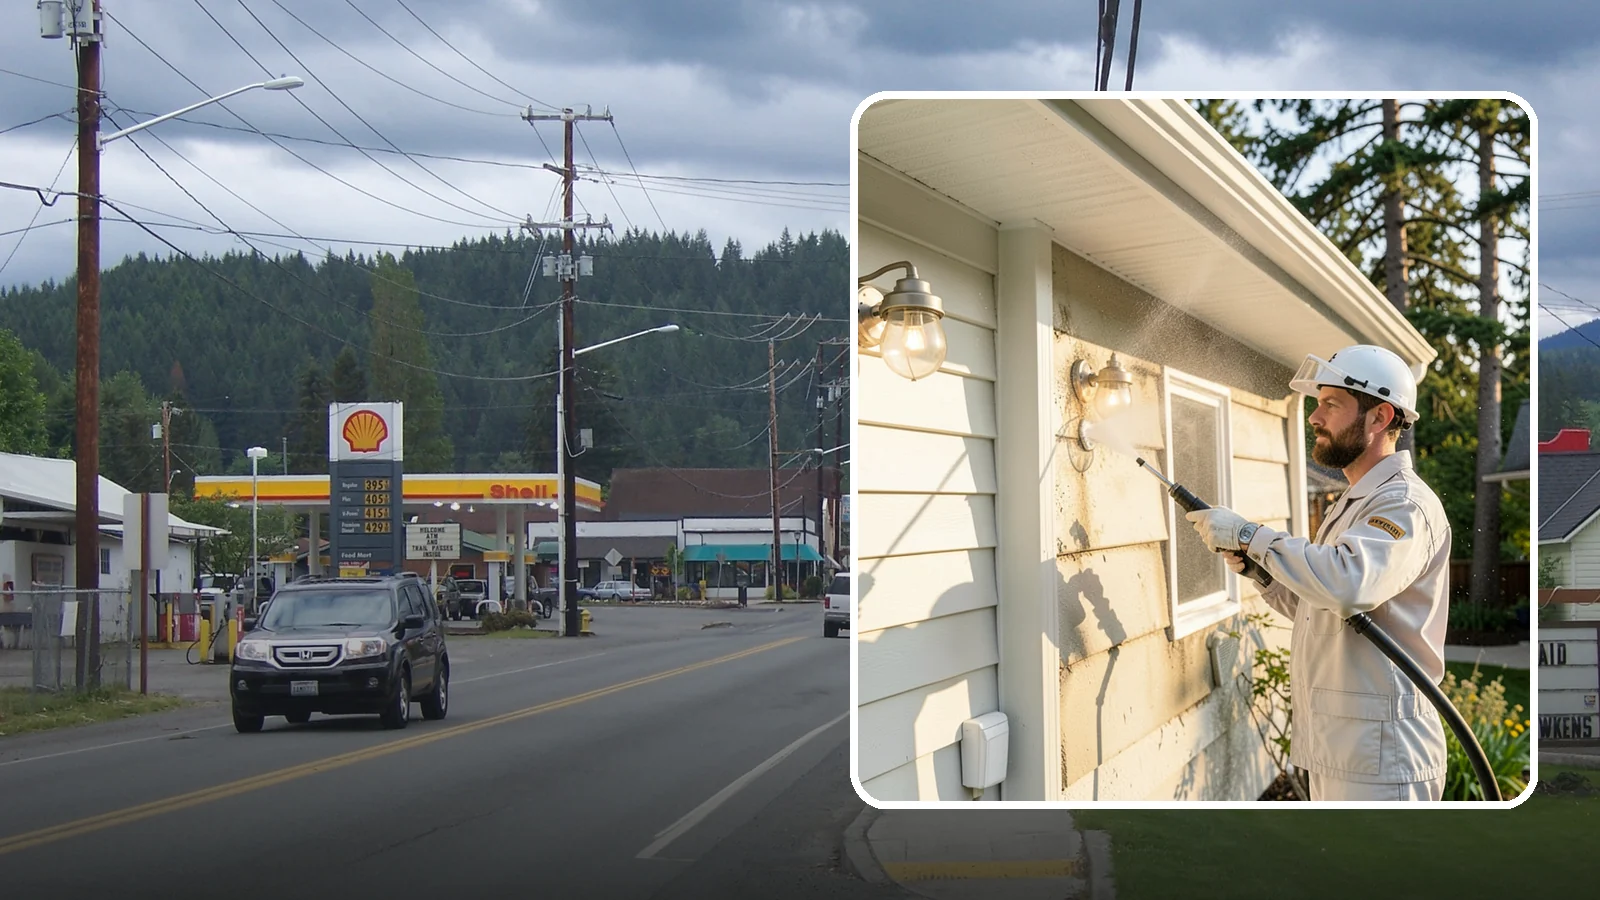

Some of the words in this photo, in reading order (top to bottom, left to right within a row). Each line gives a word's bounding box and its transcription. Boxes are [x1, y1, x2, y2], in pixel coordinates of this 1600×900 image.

[366, 480, 383, 490] 395
[490, 484, 547, 499] Shell
[365, 494, 383, 504] 405
[366, 508, 383, 518] 415
[366, 522, 383, 532] 429
